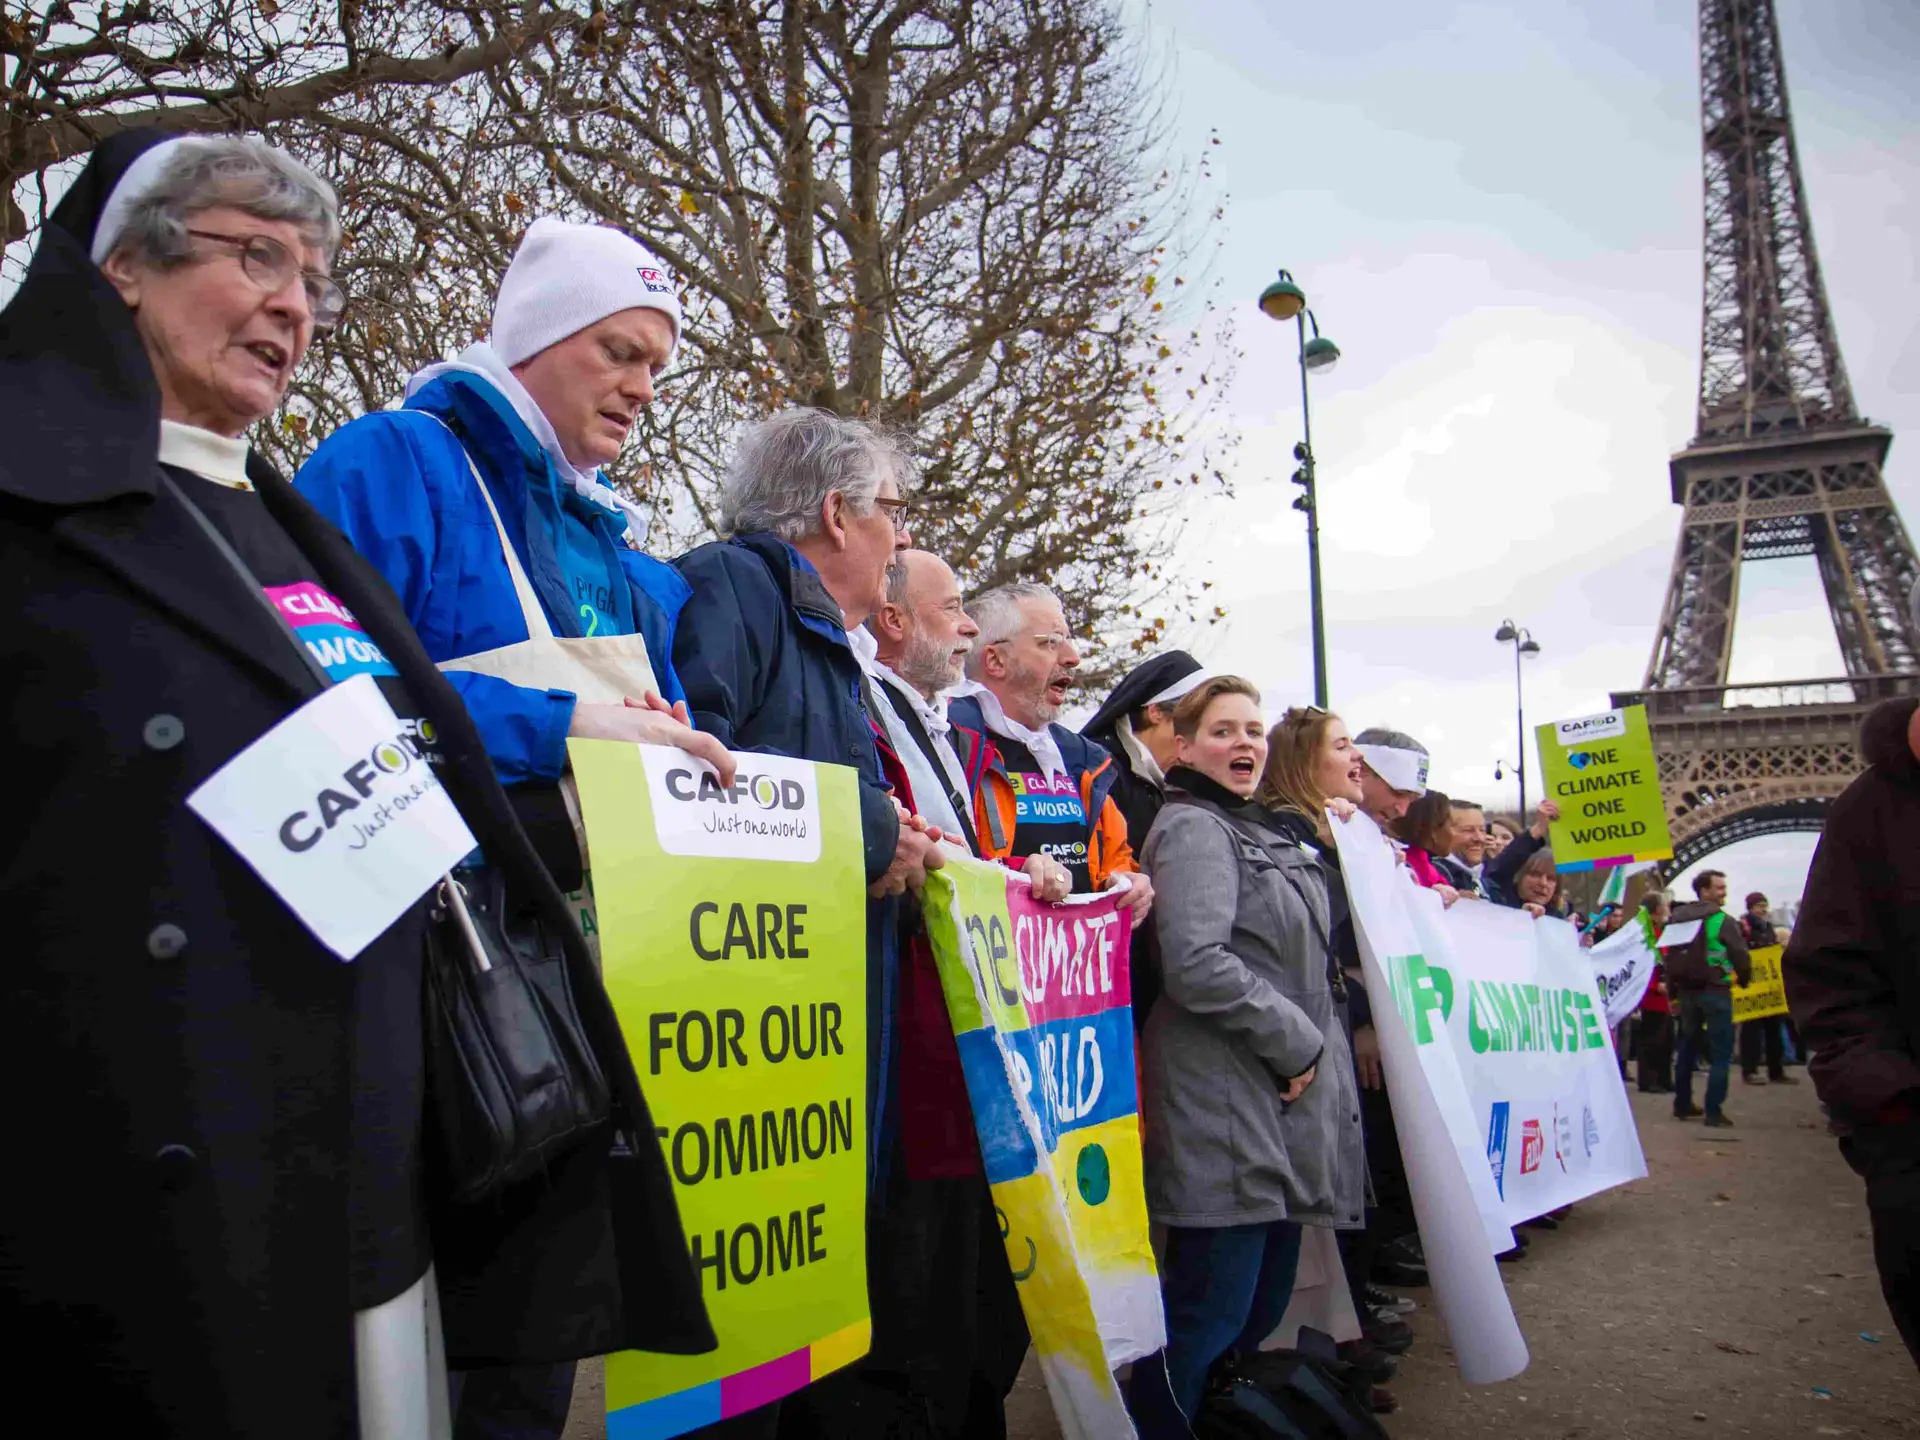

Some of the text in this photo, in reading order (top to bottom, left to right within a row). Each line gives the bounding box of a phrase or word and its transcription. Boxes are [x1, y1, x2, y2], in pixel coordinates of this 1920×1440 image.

[305, 636, 390, 668] WOR
[1561, 716, 1617, 733] CAFOD
[279, 732, 421, 853] CAFOD
[665, 768, 806, 811] CAFOD
[1557, 770, 1643, 796] CLIMATE
[1033, 801, 1082, 817] WORLD
[1582, 798, 1626, 818] ONE
[1040, 842, 1086, 856] CAFO
[1570, 820, 1646, 845] WORLD
[689, 901, 809, 961] CARE
[965, 911, 1119, 1006] ne CLIMATE
[649, 1002, 844, 1075] FOR OUR
[655, 1097, 853, 1186] OMMON
[691, 1203, 828, 1292] HOME
